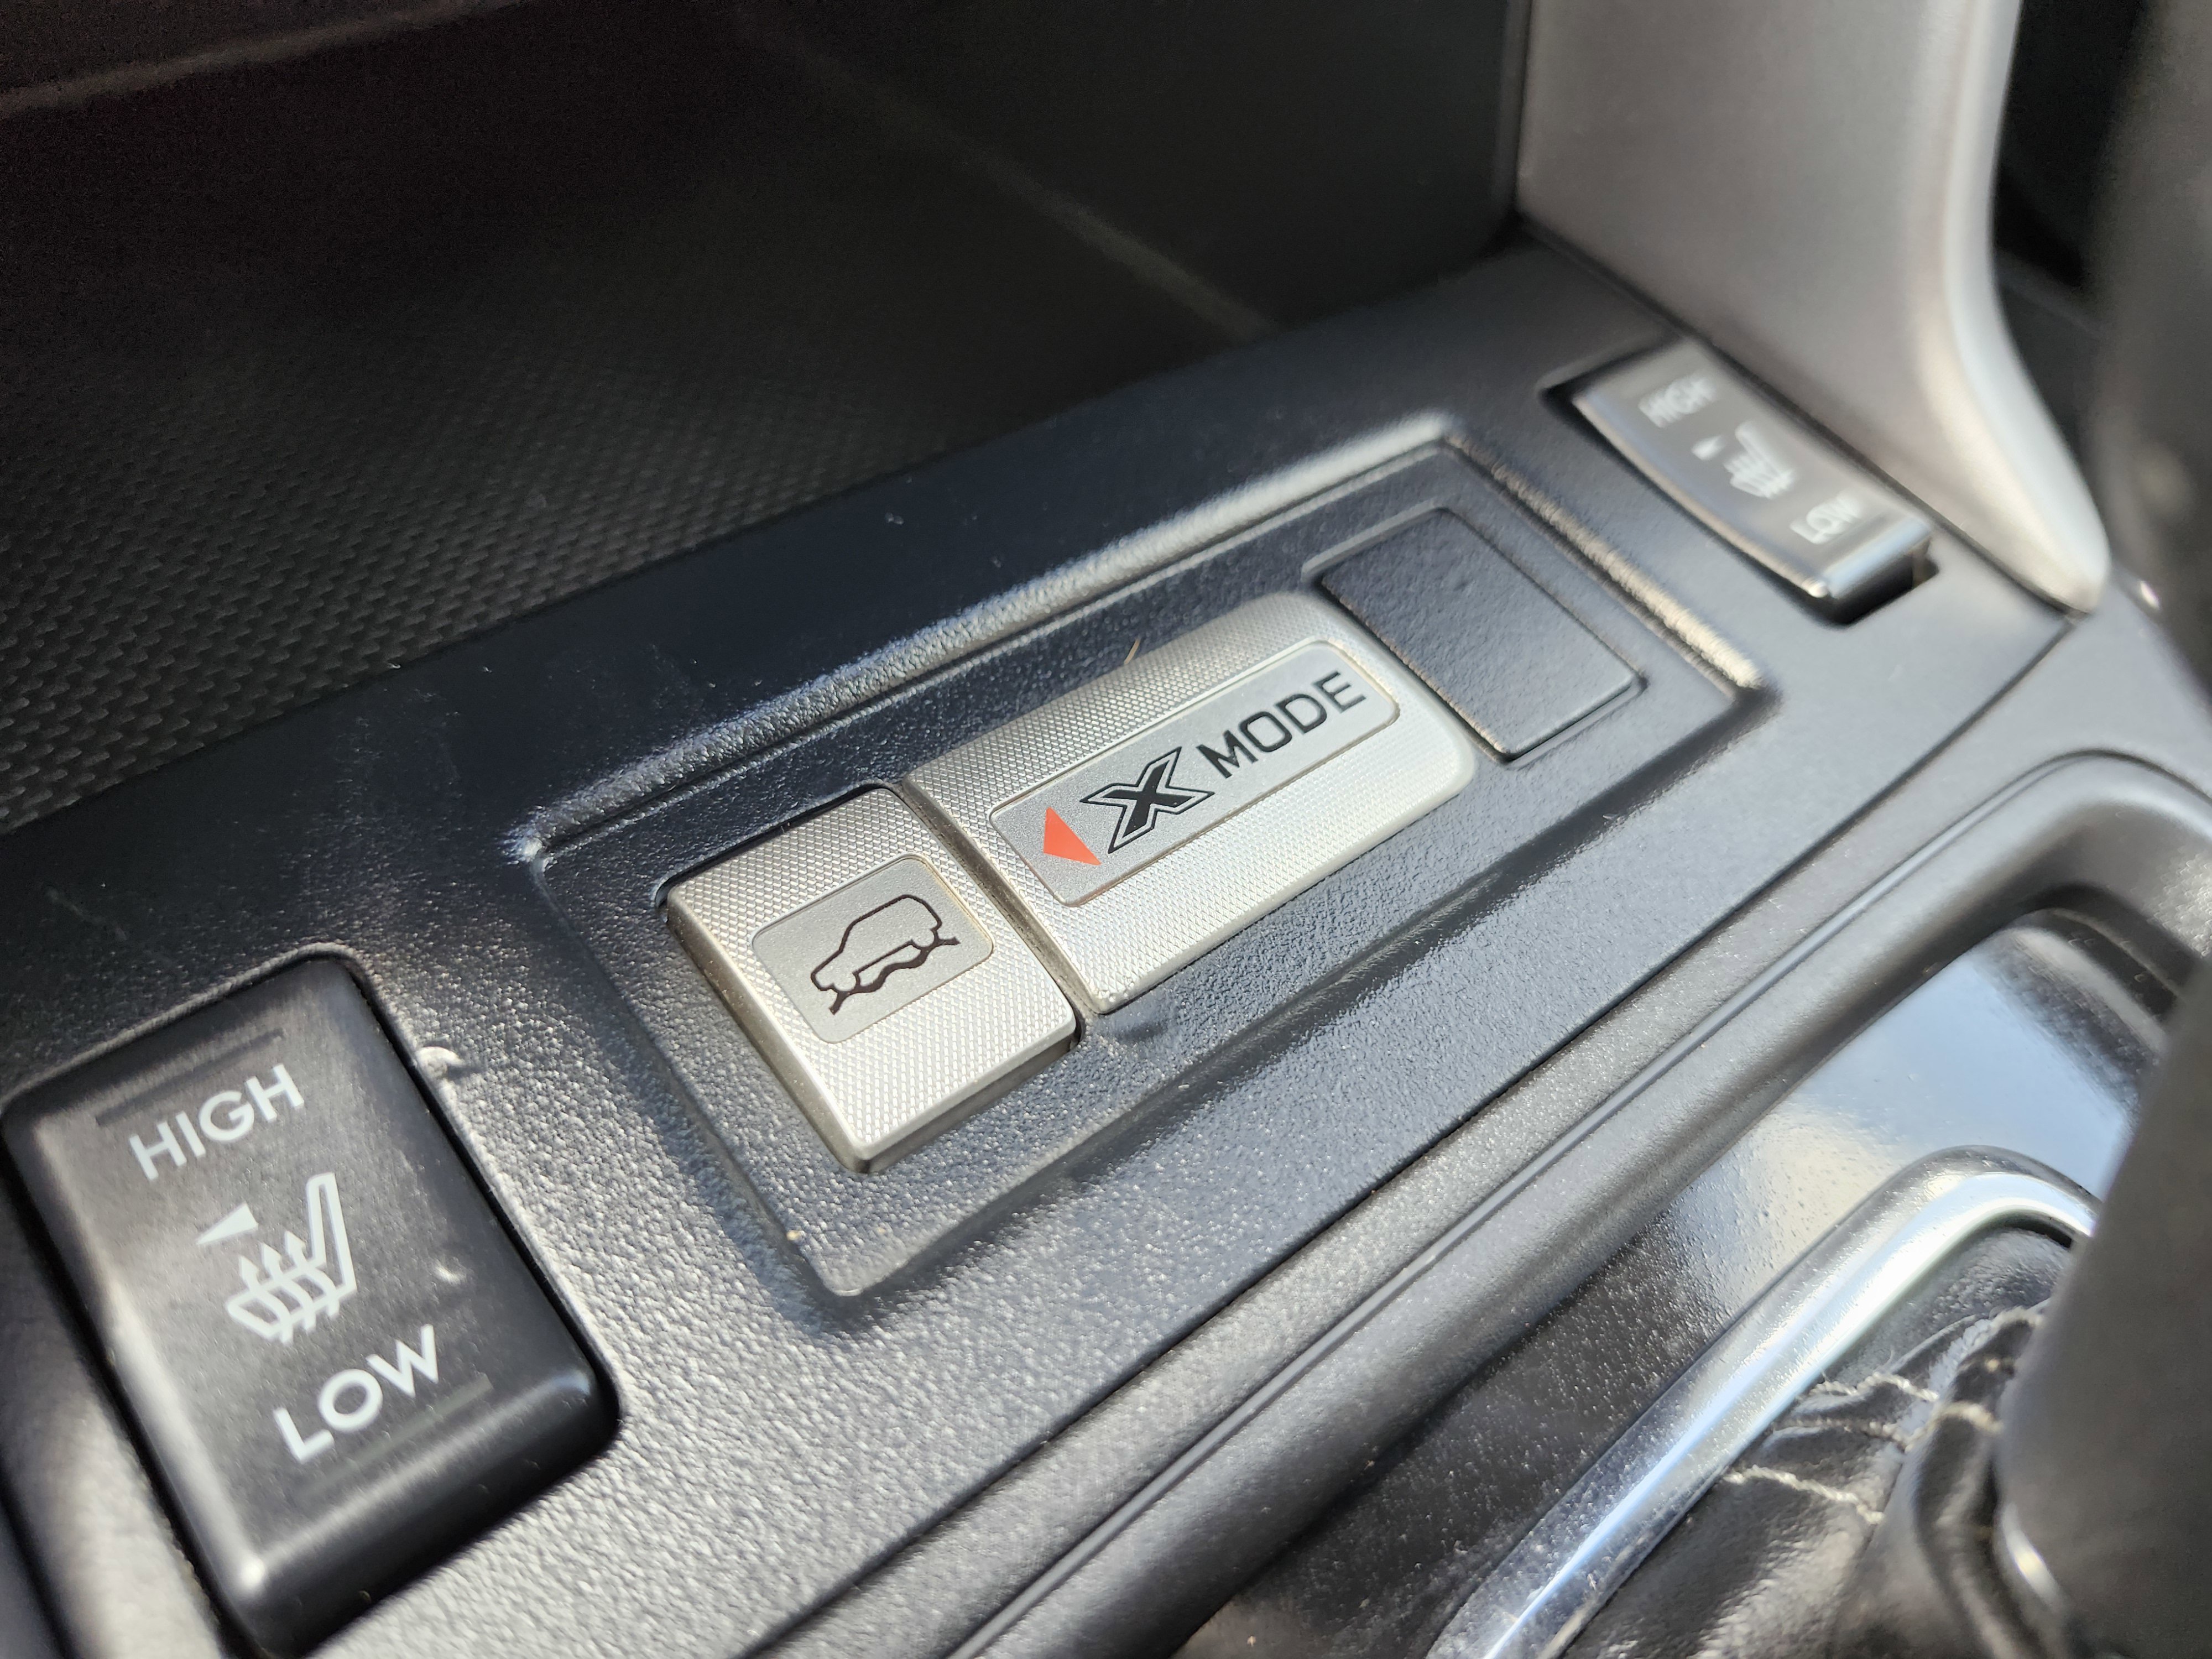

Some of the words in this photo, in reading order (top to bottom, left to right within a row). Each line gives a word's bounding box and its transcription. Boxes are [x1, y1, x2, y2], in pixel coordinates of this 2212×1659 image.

[1638, 374, 1716, 428] HIGH
[1790, 492, 1862, 545] LOW
[1081, 745, 1215, 853] X
[1197, 671, 1366, 779] MODE
[129, 1063, 305, 1181] HIGH
[274, 1324, 439, 1463] LOW
